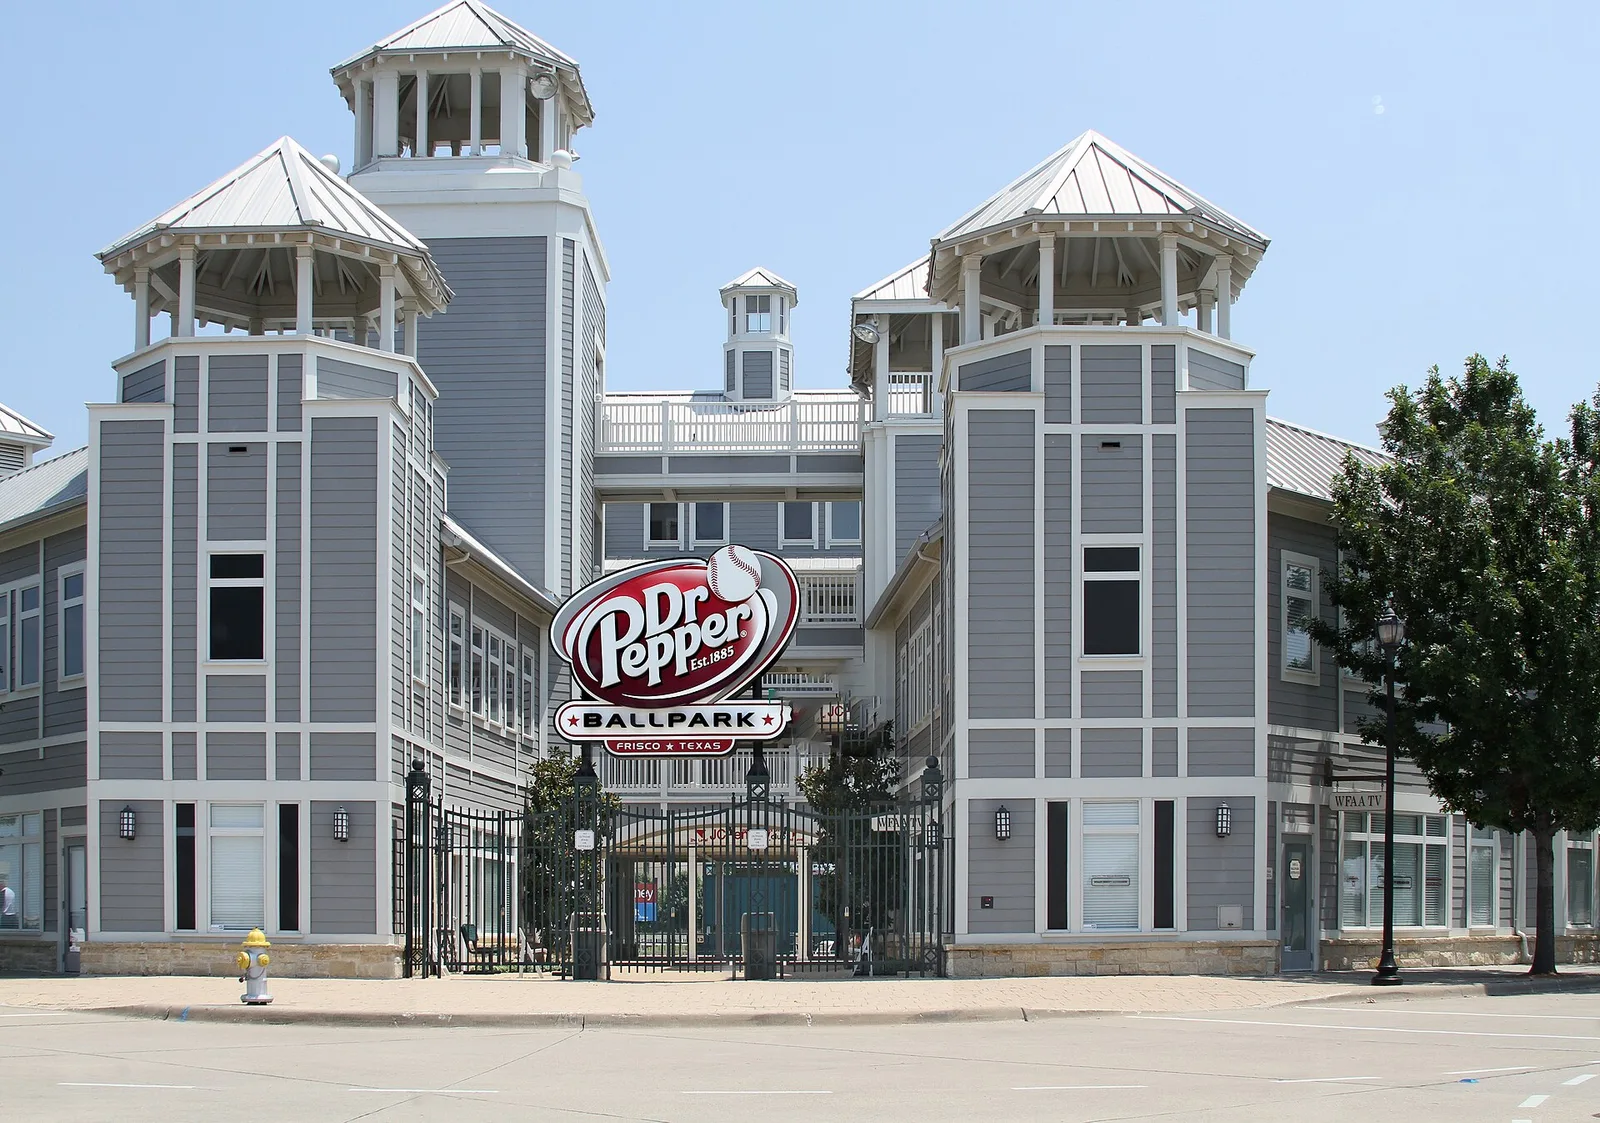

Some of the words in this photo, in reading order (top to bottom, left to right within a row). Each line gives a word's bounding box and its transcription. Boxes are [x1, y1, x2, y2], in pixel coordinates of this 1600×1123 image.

[642, 582, 709, 638] Dr
[580, 595, 753, 689] Pepper
[690, 646, 735, 671] Est.1885
[583, 712, 755, 728] BALLPARK
[616, 742, 660, 750] FRISCO
[679, 742, 721, 750] TEXAS
[1335, 796, 1366, 807] WFAA
[1368, 795, 1382, 807] TV
